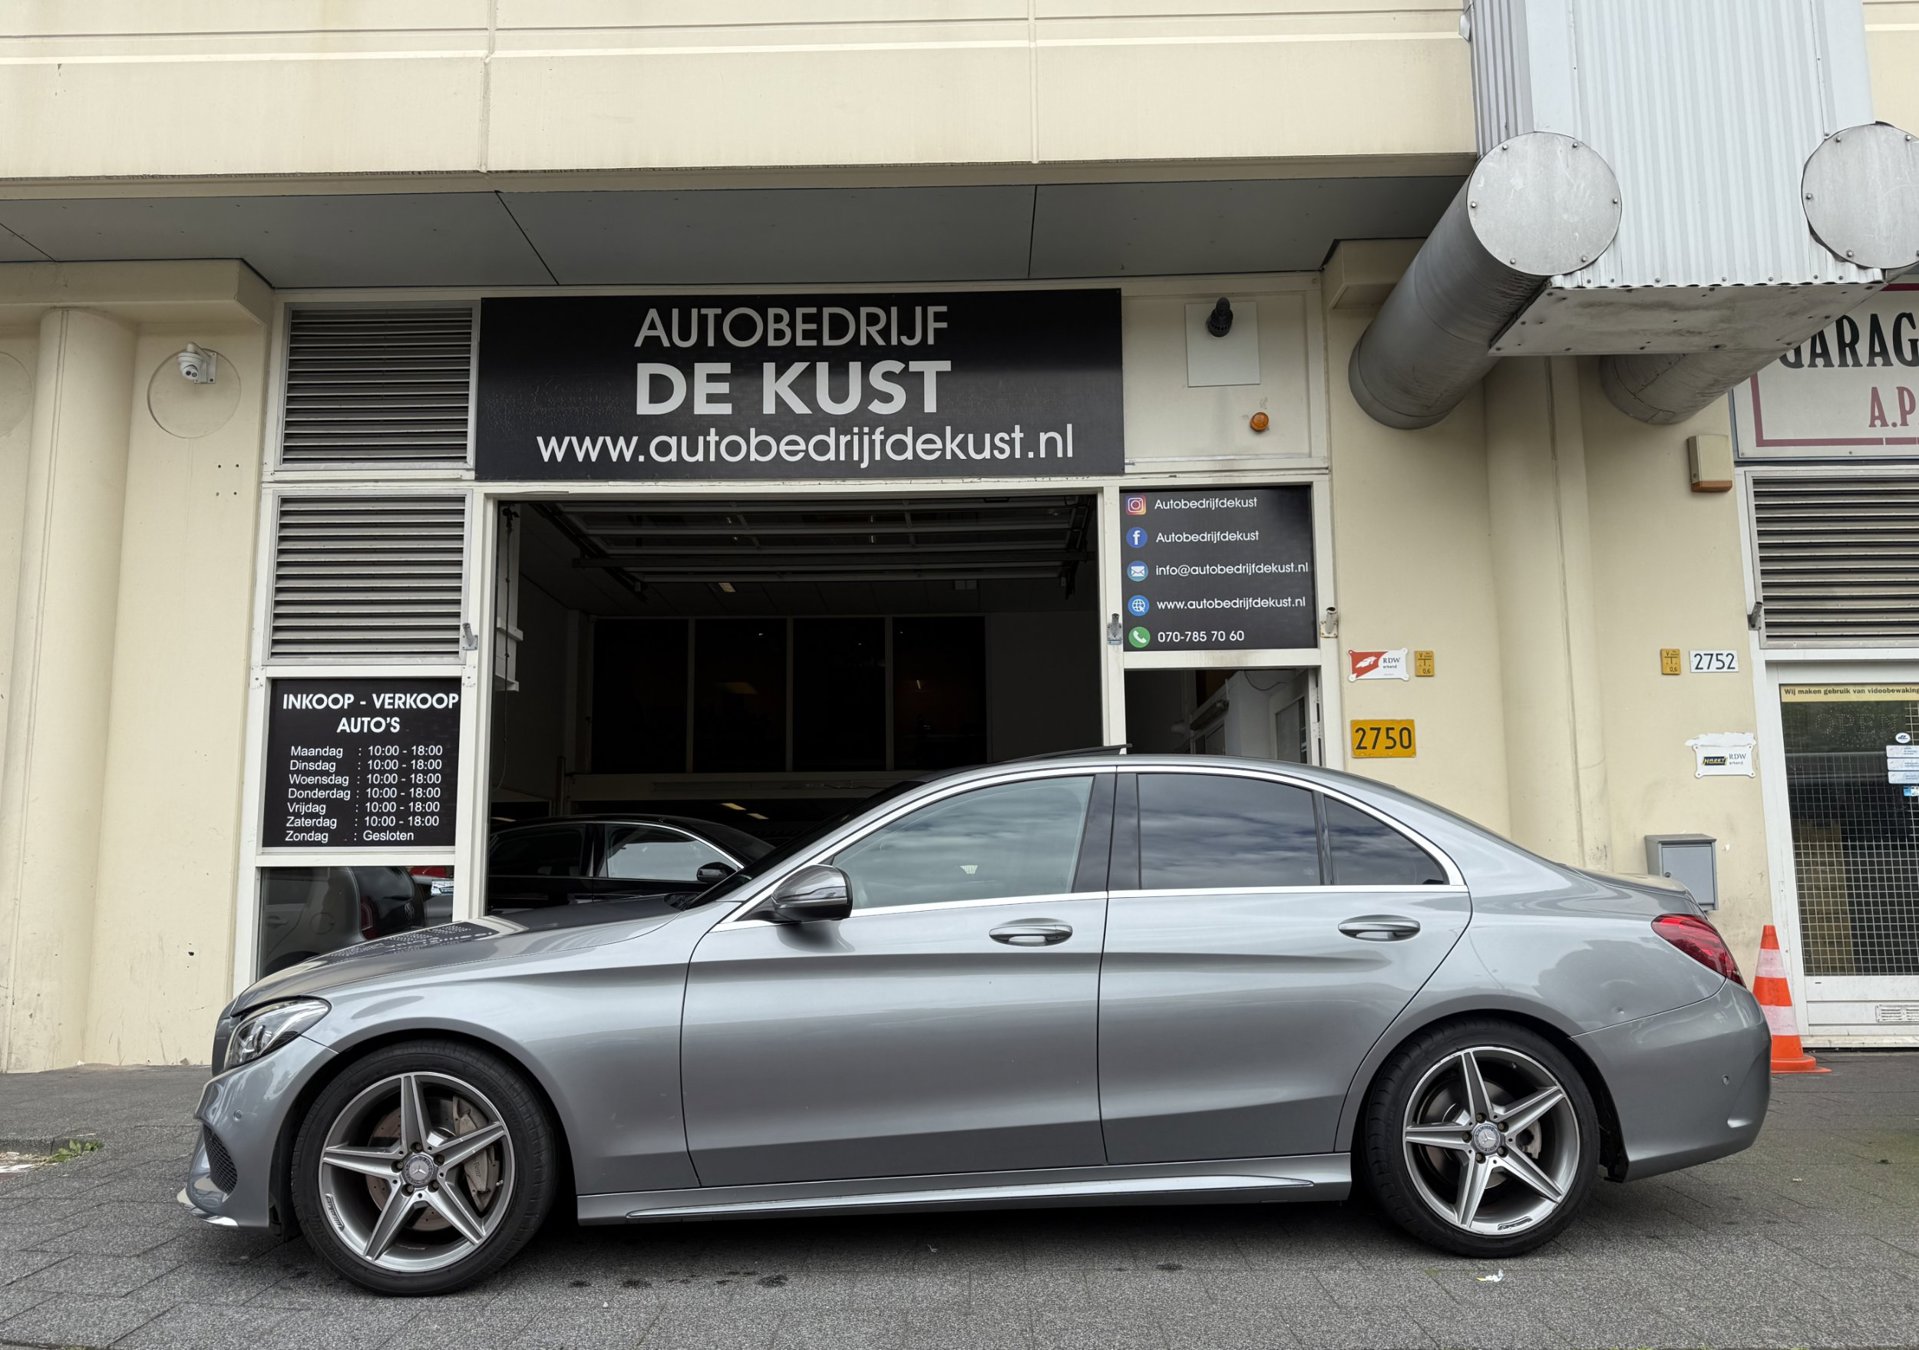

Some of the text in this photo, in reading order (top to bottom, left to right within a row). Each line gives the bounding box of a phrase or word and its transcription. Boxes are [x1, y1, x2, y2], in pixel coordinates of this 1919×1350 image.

[634, 306, 947, 347] AUTOBEDRIJF
[636, 360, 951, 416] DE KUST
[537, 424, 1073, 468] www.autobedrijfdekust.nl
[1155, 497, 1257, 510] Autobedrijfdekust
[1156, 531, 1259, 543] Autobedrijfdekust
[1156, 562, 1308, 576] info@autobedrijfdekust.nl
[1157, 597, 1305, 610] www.autobedrijfdekust.nl
[1158, 631, 1244, 642] 070-785 70 60
[1694, 653, 1736, 670] 2752
[283, 694, 354, 709] INKOOP
[372, 693, 458, 709] VERKOOP
[1355, 726, 1412, 750] 2750
[291, 746, 343, 758] Maandag
[369, 745, 399, 756] 10:00
[412, 745, 442, 755] 18:00
[290, 760, 336, 772] Dinsdag
[368, 759, 398, 770] 10:00
[411, 759, 442, 769] 18:00
[289, 774, 349, 786] Woensdag
[367, 774, 398, 784] 10:00
[410, 773, 441, 784] 18:00
[288, 788, 350, 800] Donderdag
[366, 788, 397, 798] 10:00
[410, 787, 440, 798] 18:00
[287, 802, 326, 815] Vrijdag
[366, 802, 396, 812] 10:00
[409, 802, 440, 812] 18:00
[286, 816, 337, 829] Zaterdag
[365, 816, 395, 826] 10:00
[408, 816, 439, 826] 18:00
[285, 831, 328, 843] Zondag
[363, 830, 414, 840] Gesloten
